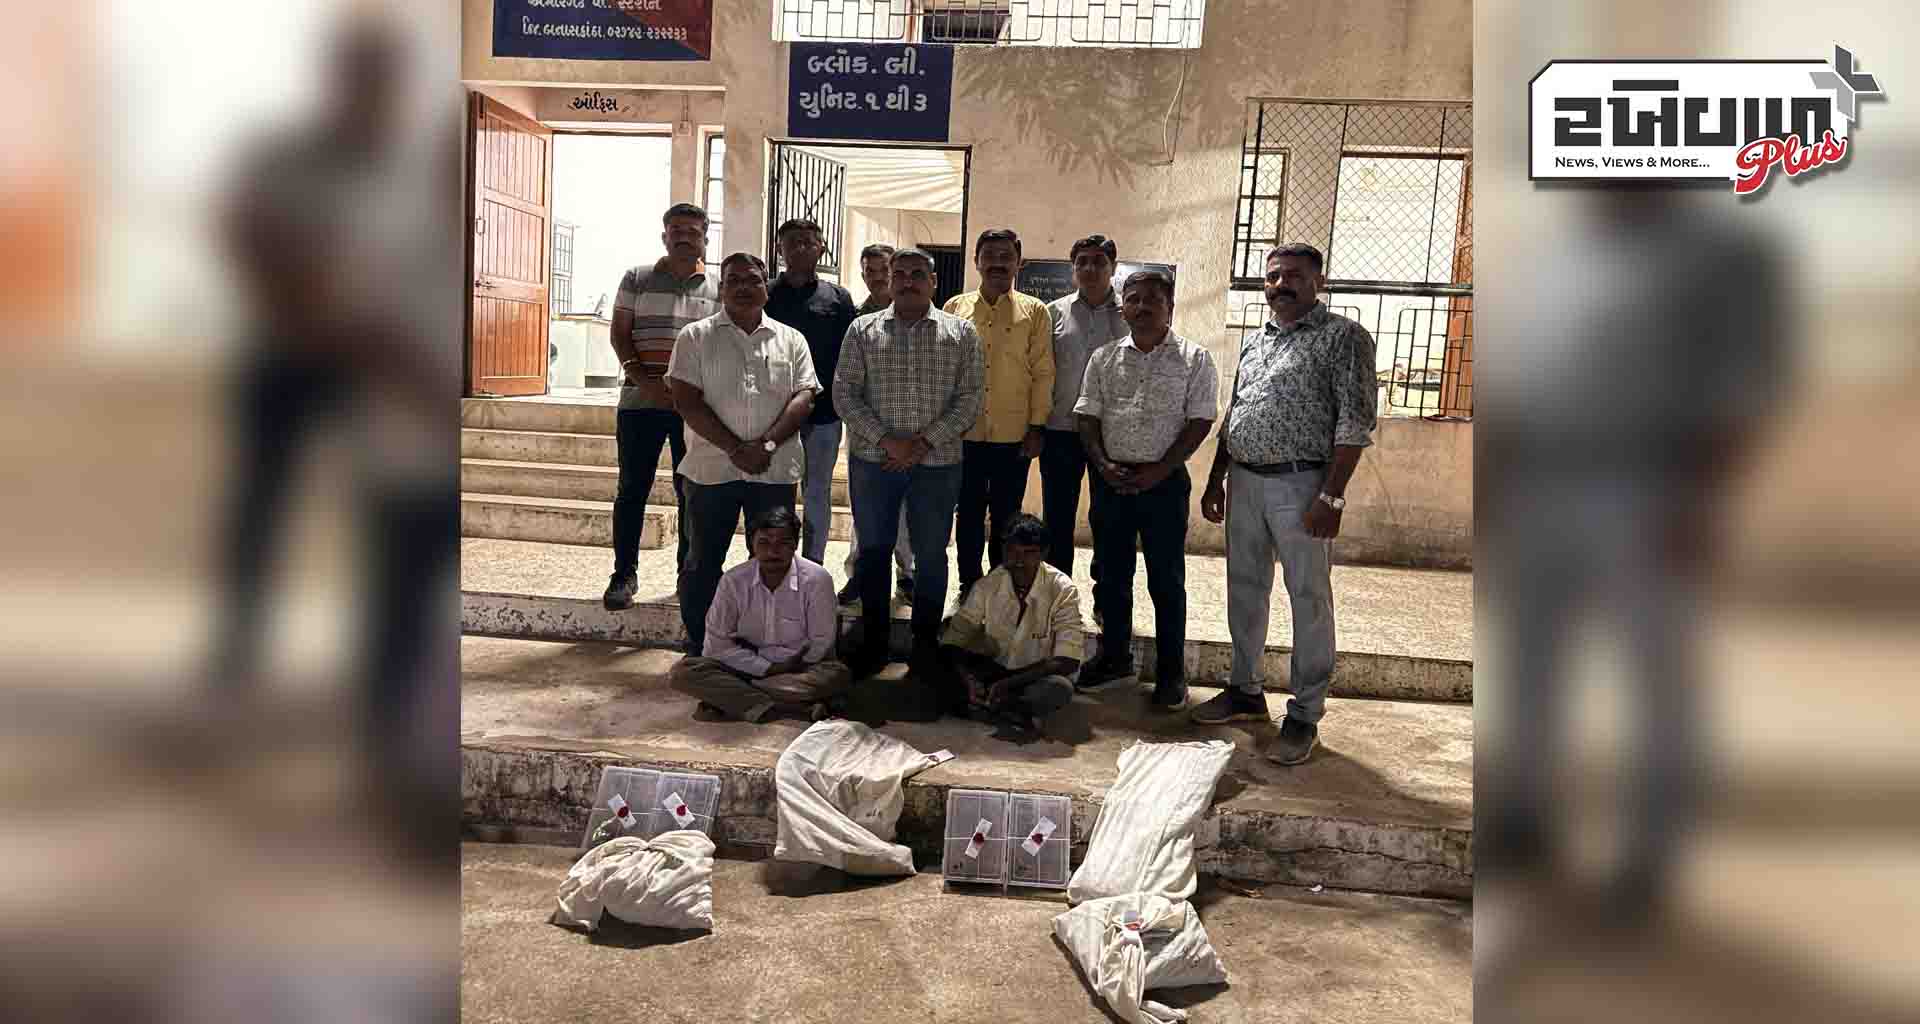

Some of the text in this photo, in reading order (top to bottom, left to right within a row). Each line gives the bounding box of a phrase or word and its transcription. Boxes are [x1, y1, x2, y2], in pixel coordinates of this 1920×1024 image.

[884, 46, 926, 76] બી.
[865, 92, 881, 112] ૧
[885, 84, 910, 112] થી
[913, 92, 929, 113] ૩
